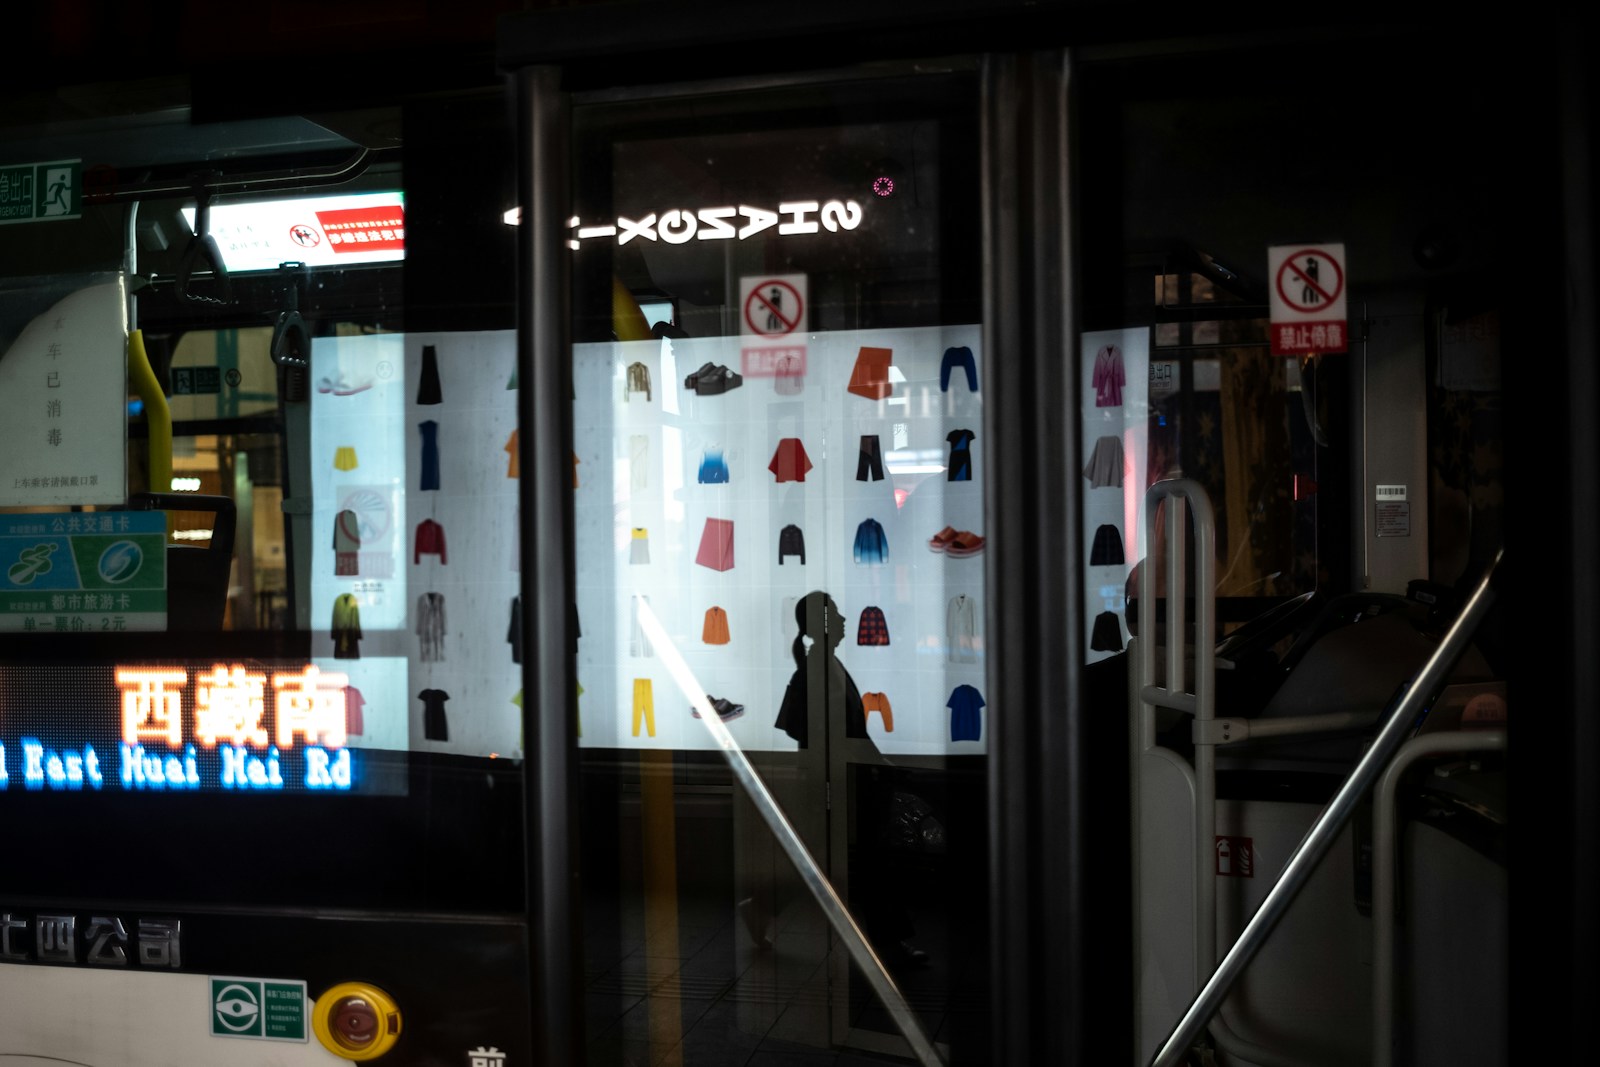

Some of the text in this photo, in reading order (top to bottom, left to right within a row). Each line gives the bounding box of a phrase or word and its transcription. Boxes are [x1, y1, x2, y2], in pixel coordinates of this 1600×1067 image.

[1279, 324, 1343, 350] 禁止倚靠
[51, 515, 131, 532] 公共交通卡
[51, 592, 132, 610] 都市旅游卡
[114, 663, 349, 749] 西藏南
[21, 738, 102, 789] East
[118, 741, 200, 790] Huai
[220, 743, 283, 790] Hai
[303, 745, 353, 790] Rd
